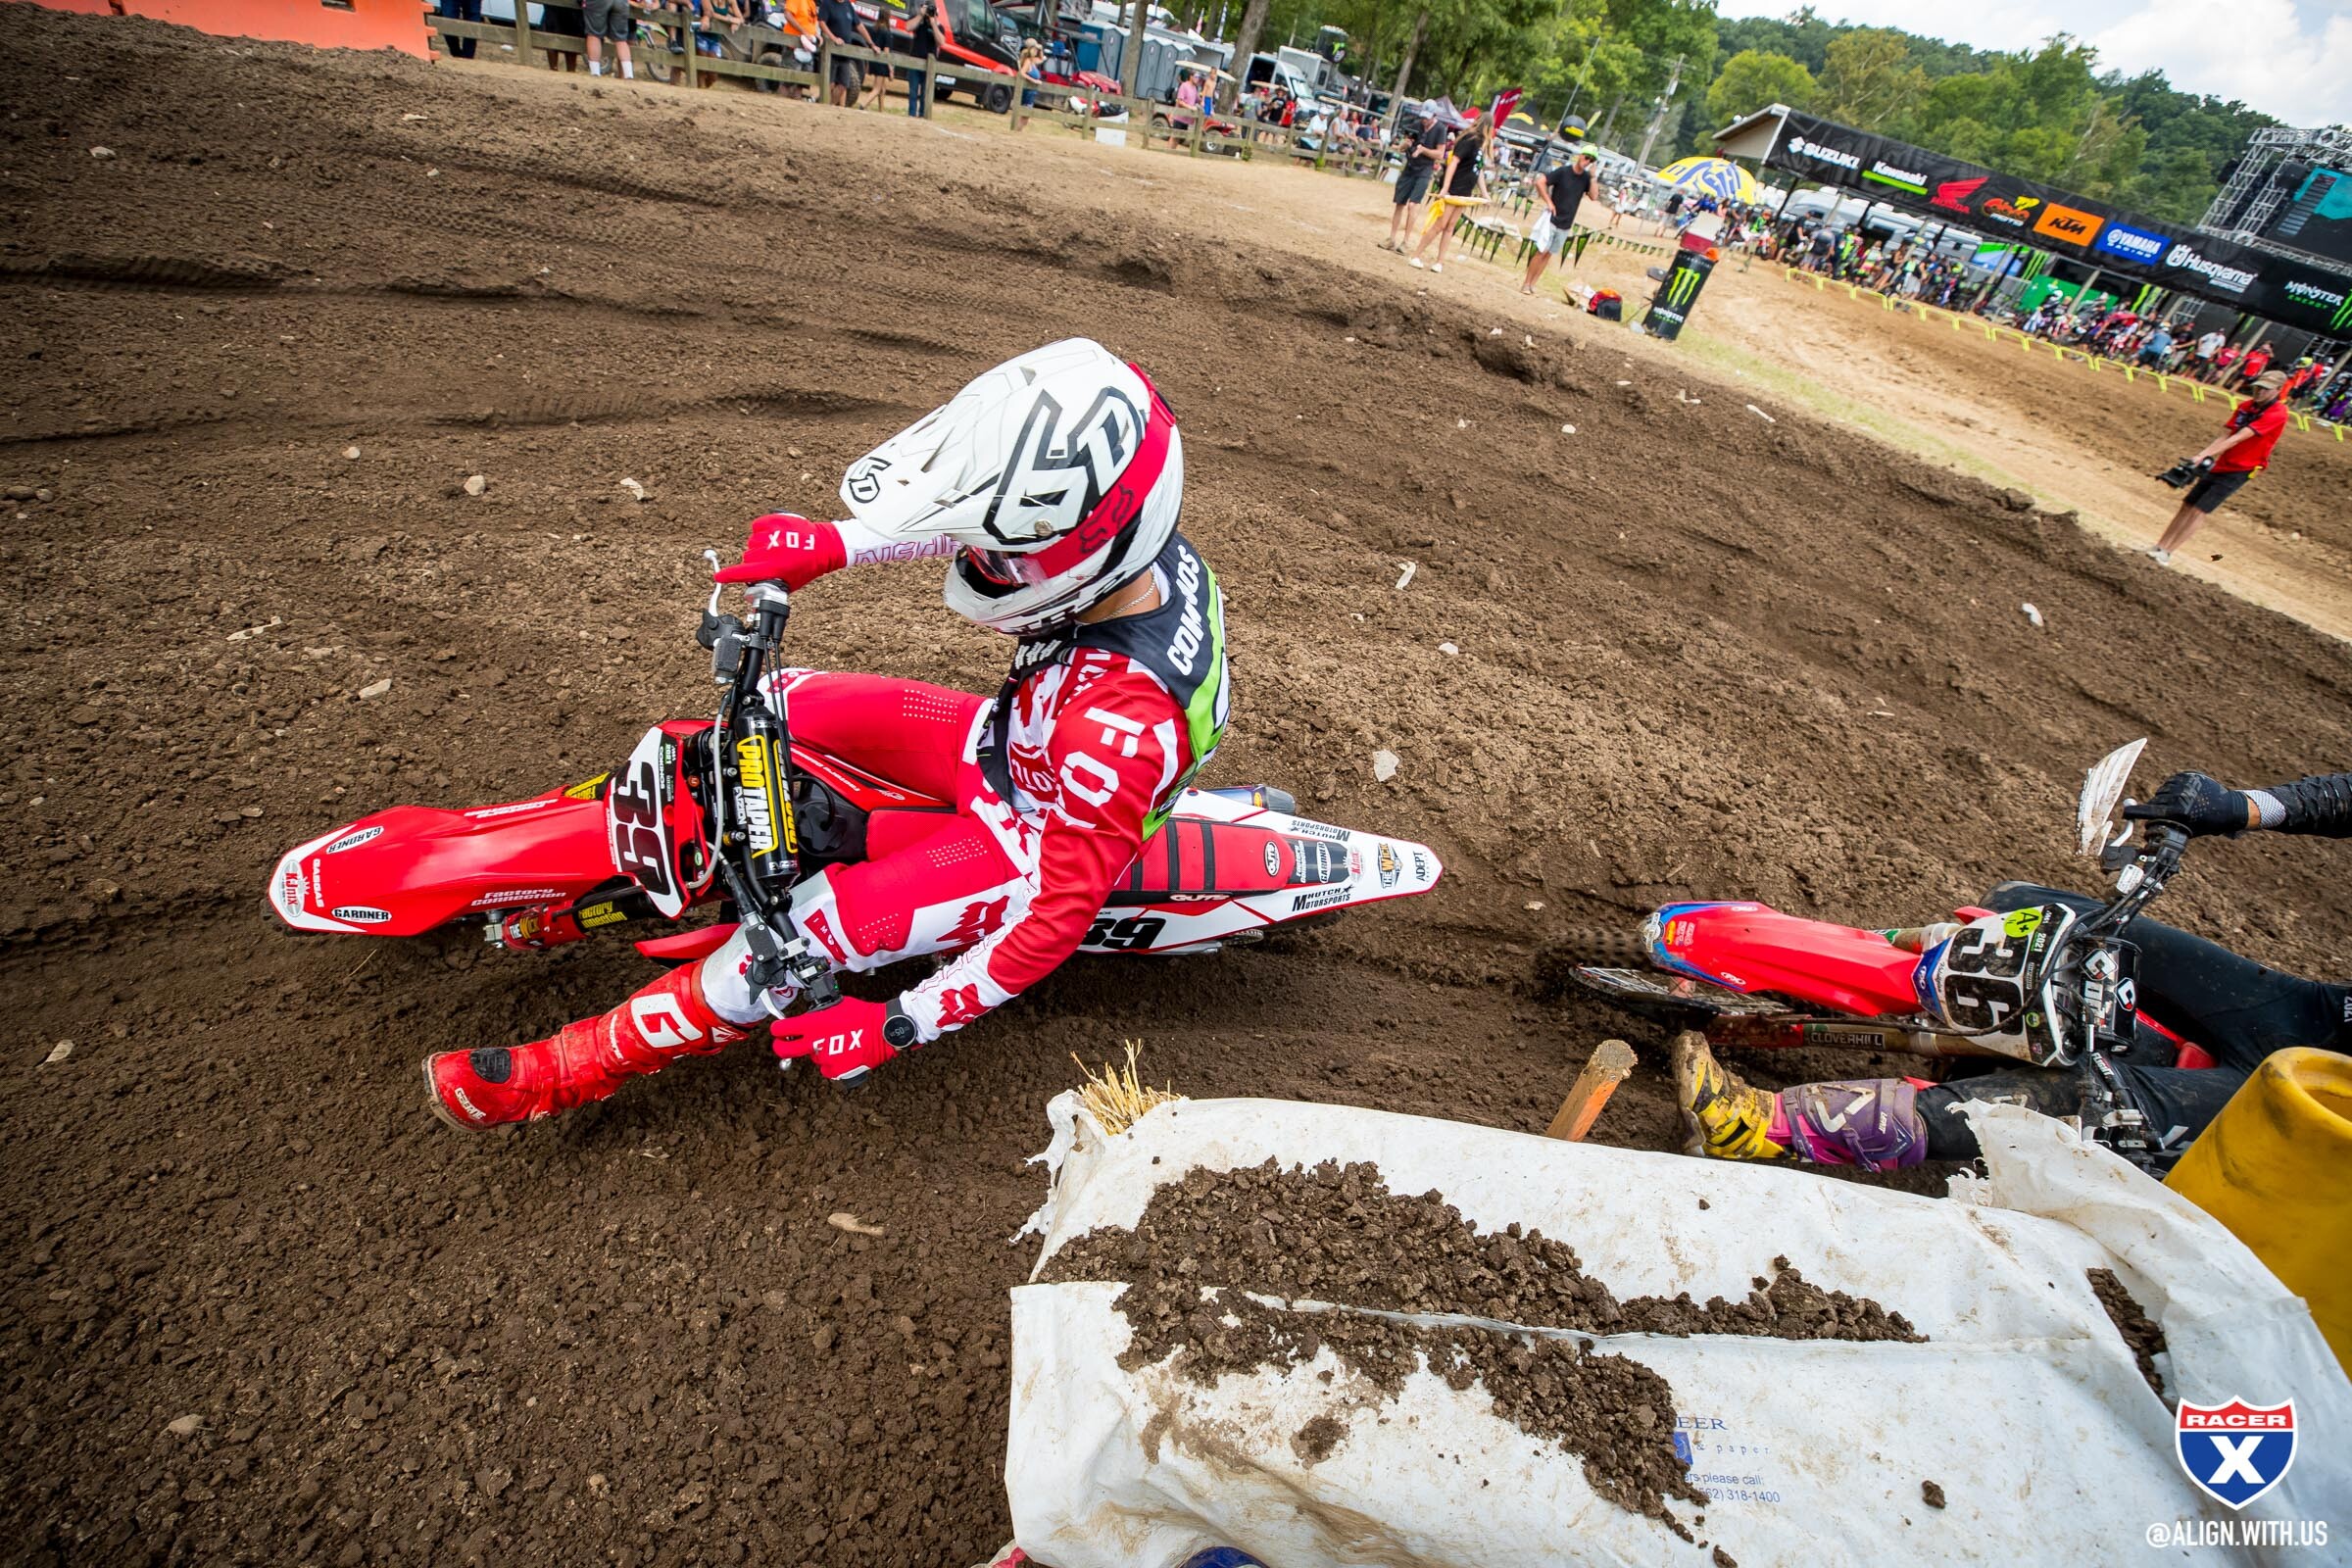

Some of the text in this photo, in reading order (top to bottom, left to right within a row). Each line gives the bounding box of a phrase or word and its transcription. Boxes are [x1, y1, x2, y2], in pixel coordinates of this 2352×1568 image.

[1803, 142, 1861, 170] SUZUKI
[1872, 161, 1928, 186] Kawasaki
[2048, 217, 2086, 235] KTM
[2121, 231, 2162, 255] YAMAHA
[2183, 252, 2258, 286] Husqvarna
[766, 530, 815, 551] FOX
[612, 760, 671, 896] 39
[328, 826, 382, 854] GARDNER
[1318, 842, 1328, 882] GARDNER
[1413, 851, 1426, 882] ADEPT
[1383, 870, 1393, 889] THE
[483, 888, 555, 899] Factory
[1292, 893, 1351, 912] MOTORSPORTS
[1305, 887, 1342, 899] HUTCH
[334, 908, 389, 920] GARDNER
[2016, 911, 2039, 933] A+
[2035, 932, 2047, 953] 2021
[1944, 927, 2030, 1036] 36
[812, 1029, 863, 1056] FOX
[1811, 1032, 1884, 1047] CLOVERHILL
[1701, 1472, 1740, 1485] please
[1727, 1489, 1781, 1503] 318-1400
